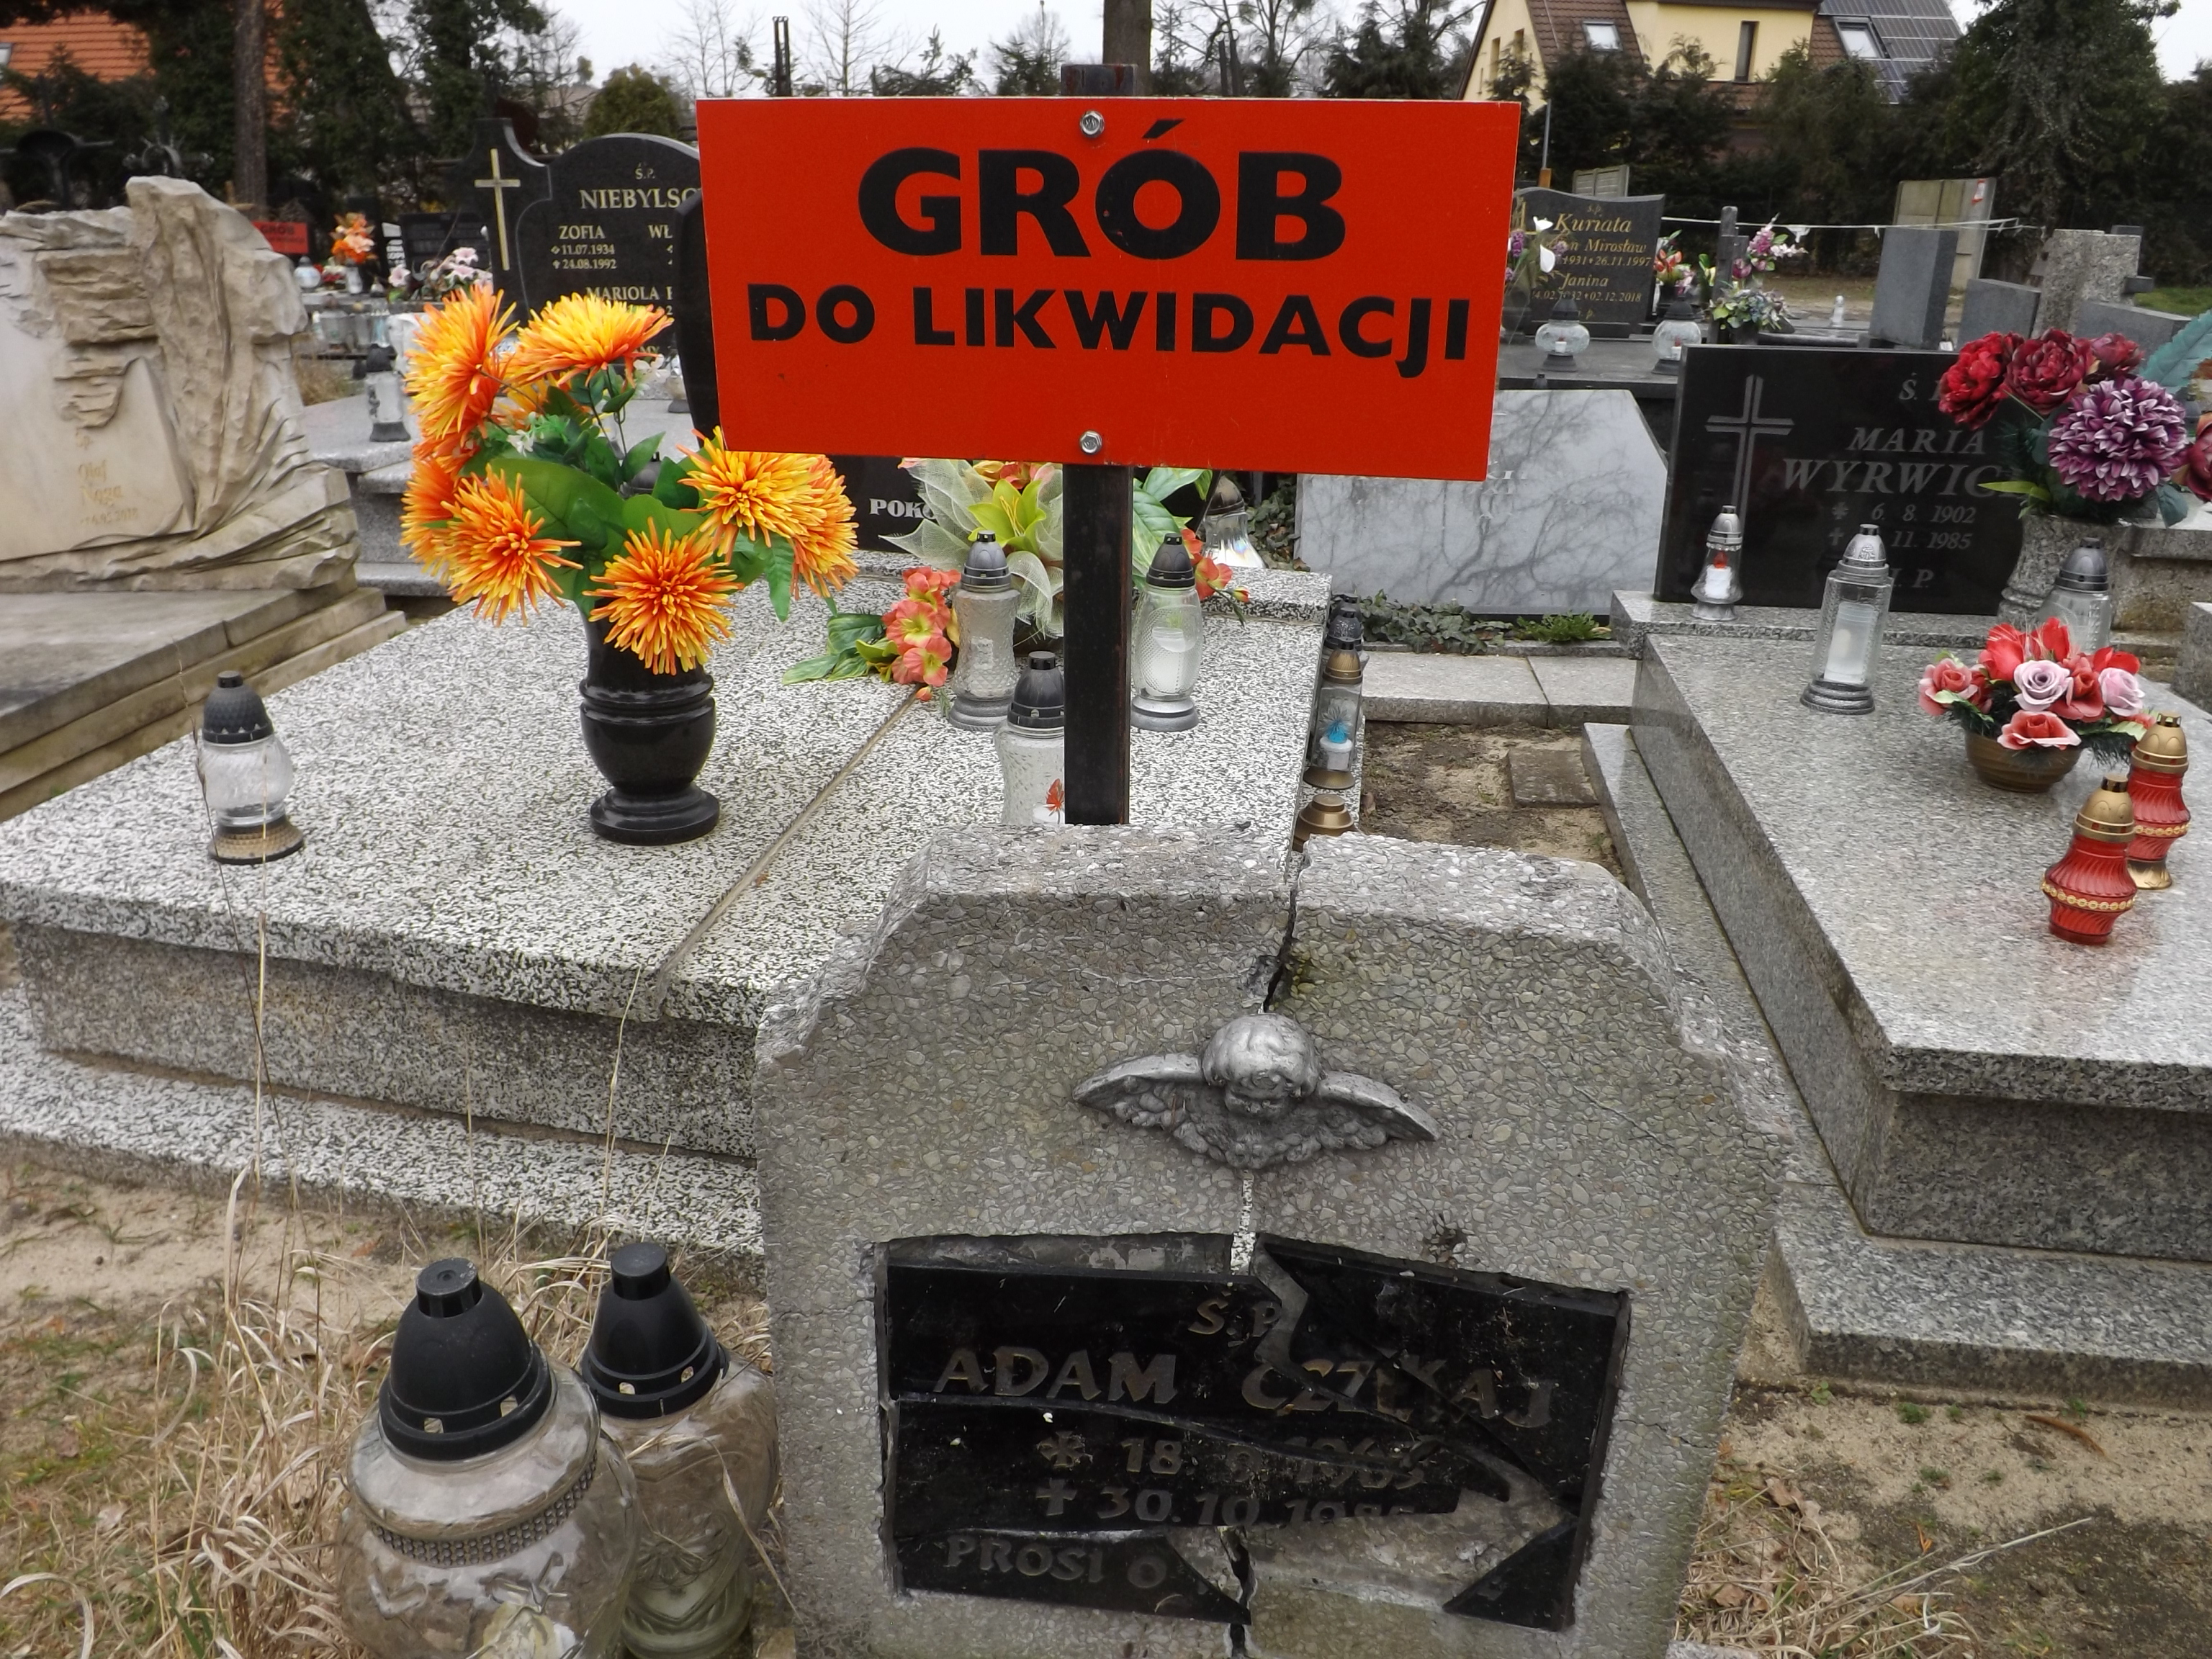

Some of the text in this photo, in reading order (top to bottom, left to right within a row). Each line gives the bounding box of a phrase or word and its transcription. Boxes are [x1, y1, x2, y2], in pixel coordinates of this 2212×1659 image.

[858, 119, 1346, 261] GRÓB
[558, 224, 606, 240] ZOFIA
[561, 244, 616, 256] 11.07.1934
[1584, 238, 1647, 253] Mirosław
[562, 258, 618, 270] 24.08.1992
[1594, 256, 1653, 266] 26.11.1997
[1559, 273, 1610, 289] Janina
[748, 284, 1470, 379] DO LIKWIDACJI
[1845, 427, 1986, 455] MARIA
[1930, 505, 1977, 524] 1902
[1927, 531, 1973, 550] 1985
[933, 1346, 1178, 1405] ADAM
[944, 1534, 1105, 1584] PROSI
[1126, 1555, 1168, 1590] O
